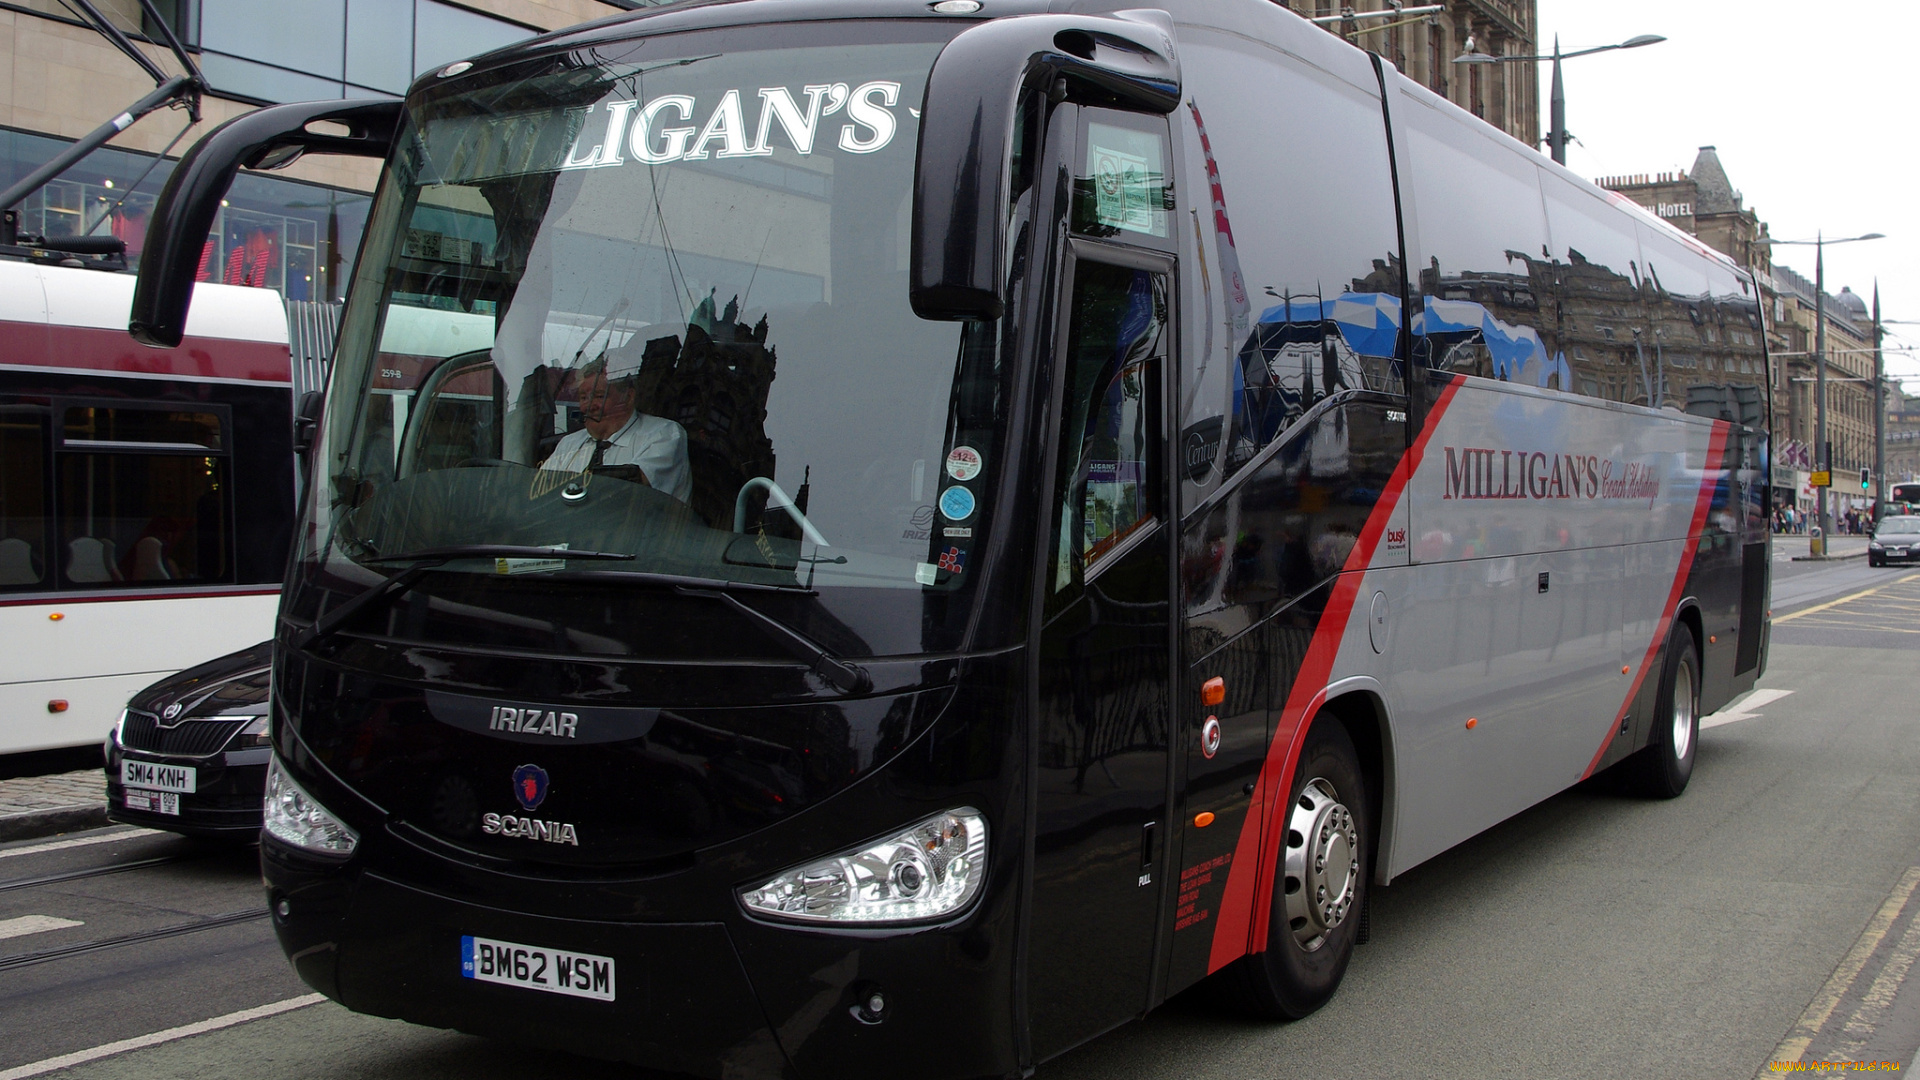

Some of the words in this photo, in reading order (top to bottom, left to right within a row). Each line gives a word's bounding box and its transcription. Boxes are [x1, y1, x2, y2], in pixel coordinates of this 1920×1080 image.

[1657, 201, 1694, 218] HOTEL
[381, 368, 402, 379] 259-B
[1443, 446, 1598, 500] MILLIGAN'S
[489, 706, 579, 738] IRIZAR
[127, 762, 154, 785] SM14
[157, 766, 187, 789] KNH
[482, 812, 579, 846] SCANIA
[1138, 873, 1152, 887] PULL
[479, 943, 548, 984] BM62
[556, 954, 611, 994] WSM
